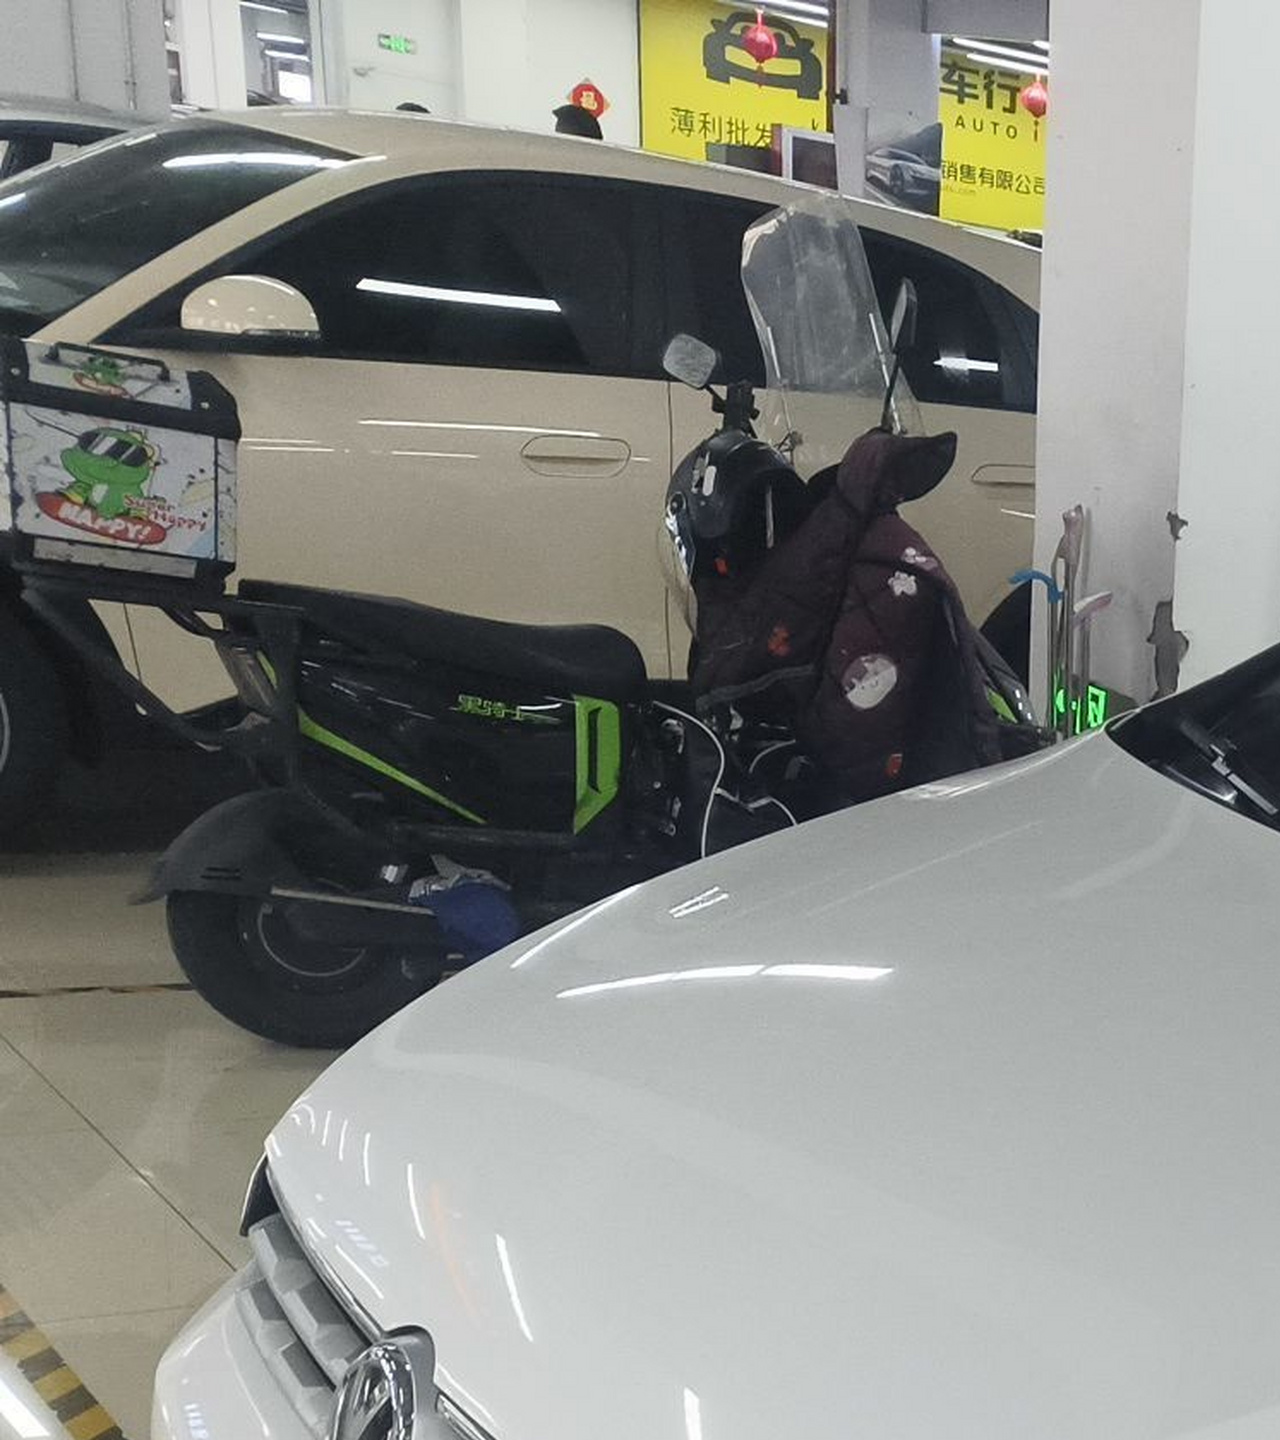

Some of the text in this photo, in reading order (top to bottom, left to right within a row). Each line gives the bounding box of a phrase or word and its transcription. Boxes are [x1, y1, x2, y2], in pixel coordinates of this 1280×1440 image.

[940, 63, 1020, 113] 车行
[670, 107, 773, 148] 薄利批发
[955, 115, 1017, 139] AUTO
